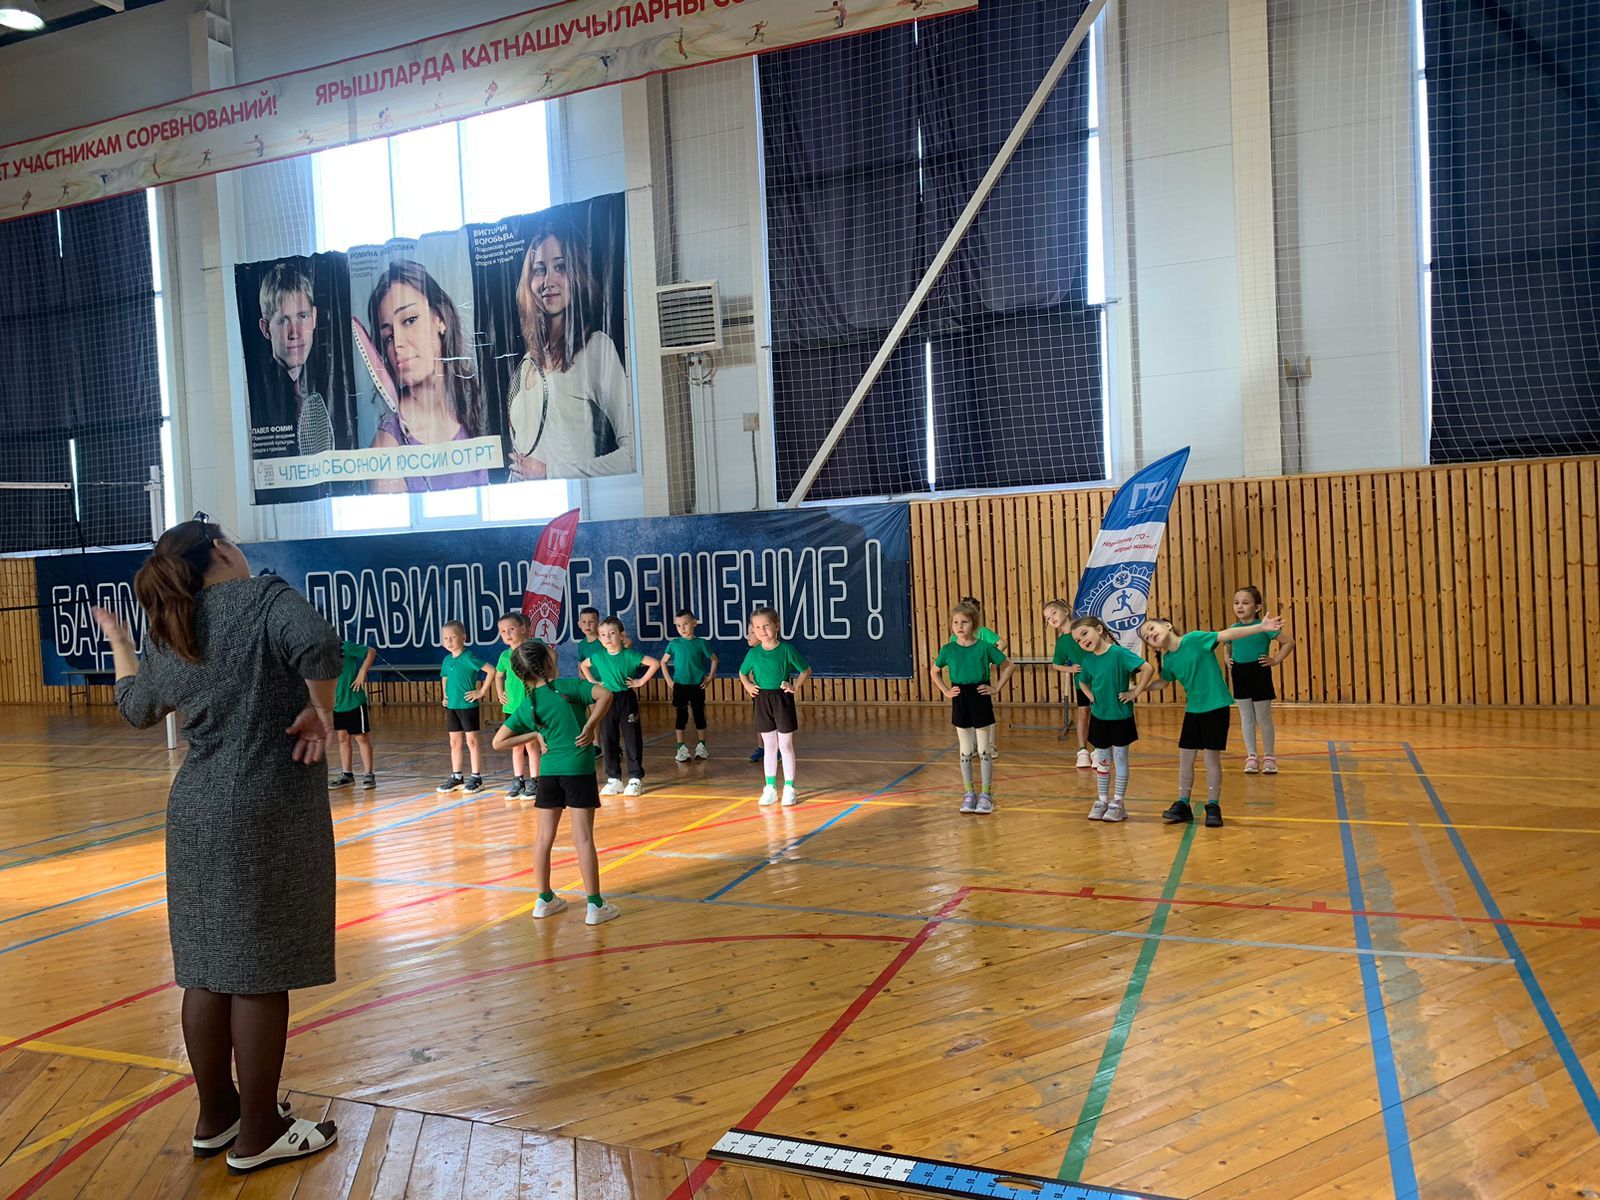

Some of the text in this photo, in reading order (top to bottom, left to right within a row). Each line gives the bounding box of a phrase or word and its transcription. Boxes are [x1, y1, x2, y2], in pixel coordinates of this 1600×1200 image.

[316, 0, 705, 106] ЯРЫШЛАРДА КАТНАШУЧЫЛАРНЫ
[0, 90, 278, 181] Т УЧАСТНИКАМ СОРЕВНОВАНИЙ!
[270, 424, 294, 433] ФОМИН
[278, 463, 321, 481] ЧЛЕНЫ
[451, 447, 473, 466] ОТ
[475, 444, 495, 463] РТ
[306, 555, 593, 649] ПРАВИЛЬНЕ
[605, 545, 851, 641] РЕШЕНИЕ
[1115, 616, 1140, 630] ГТО
